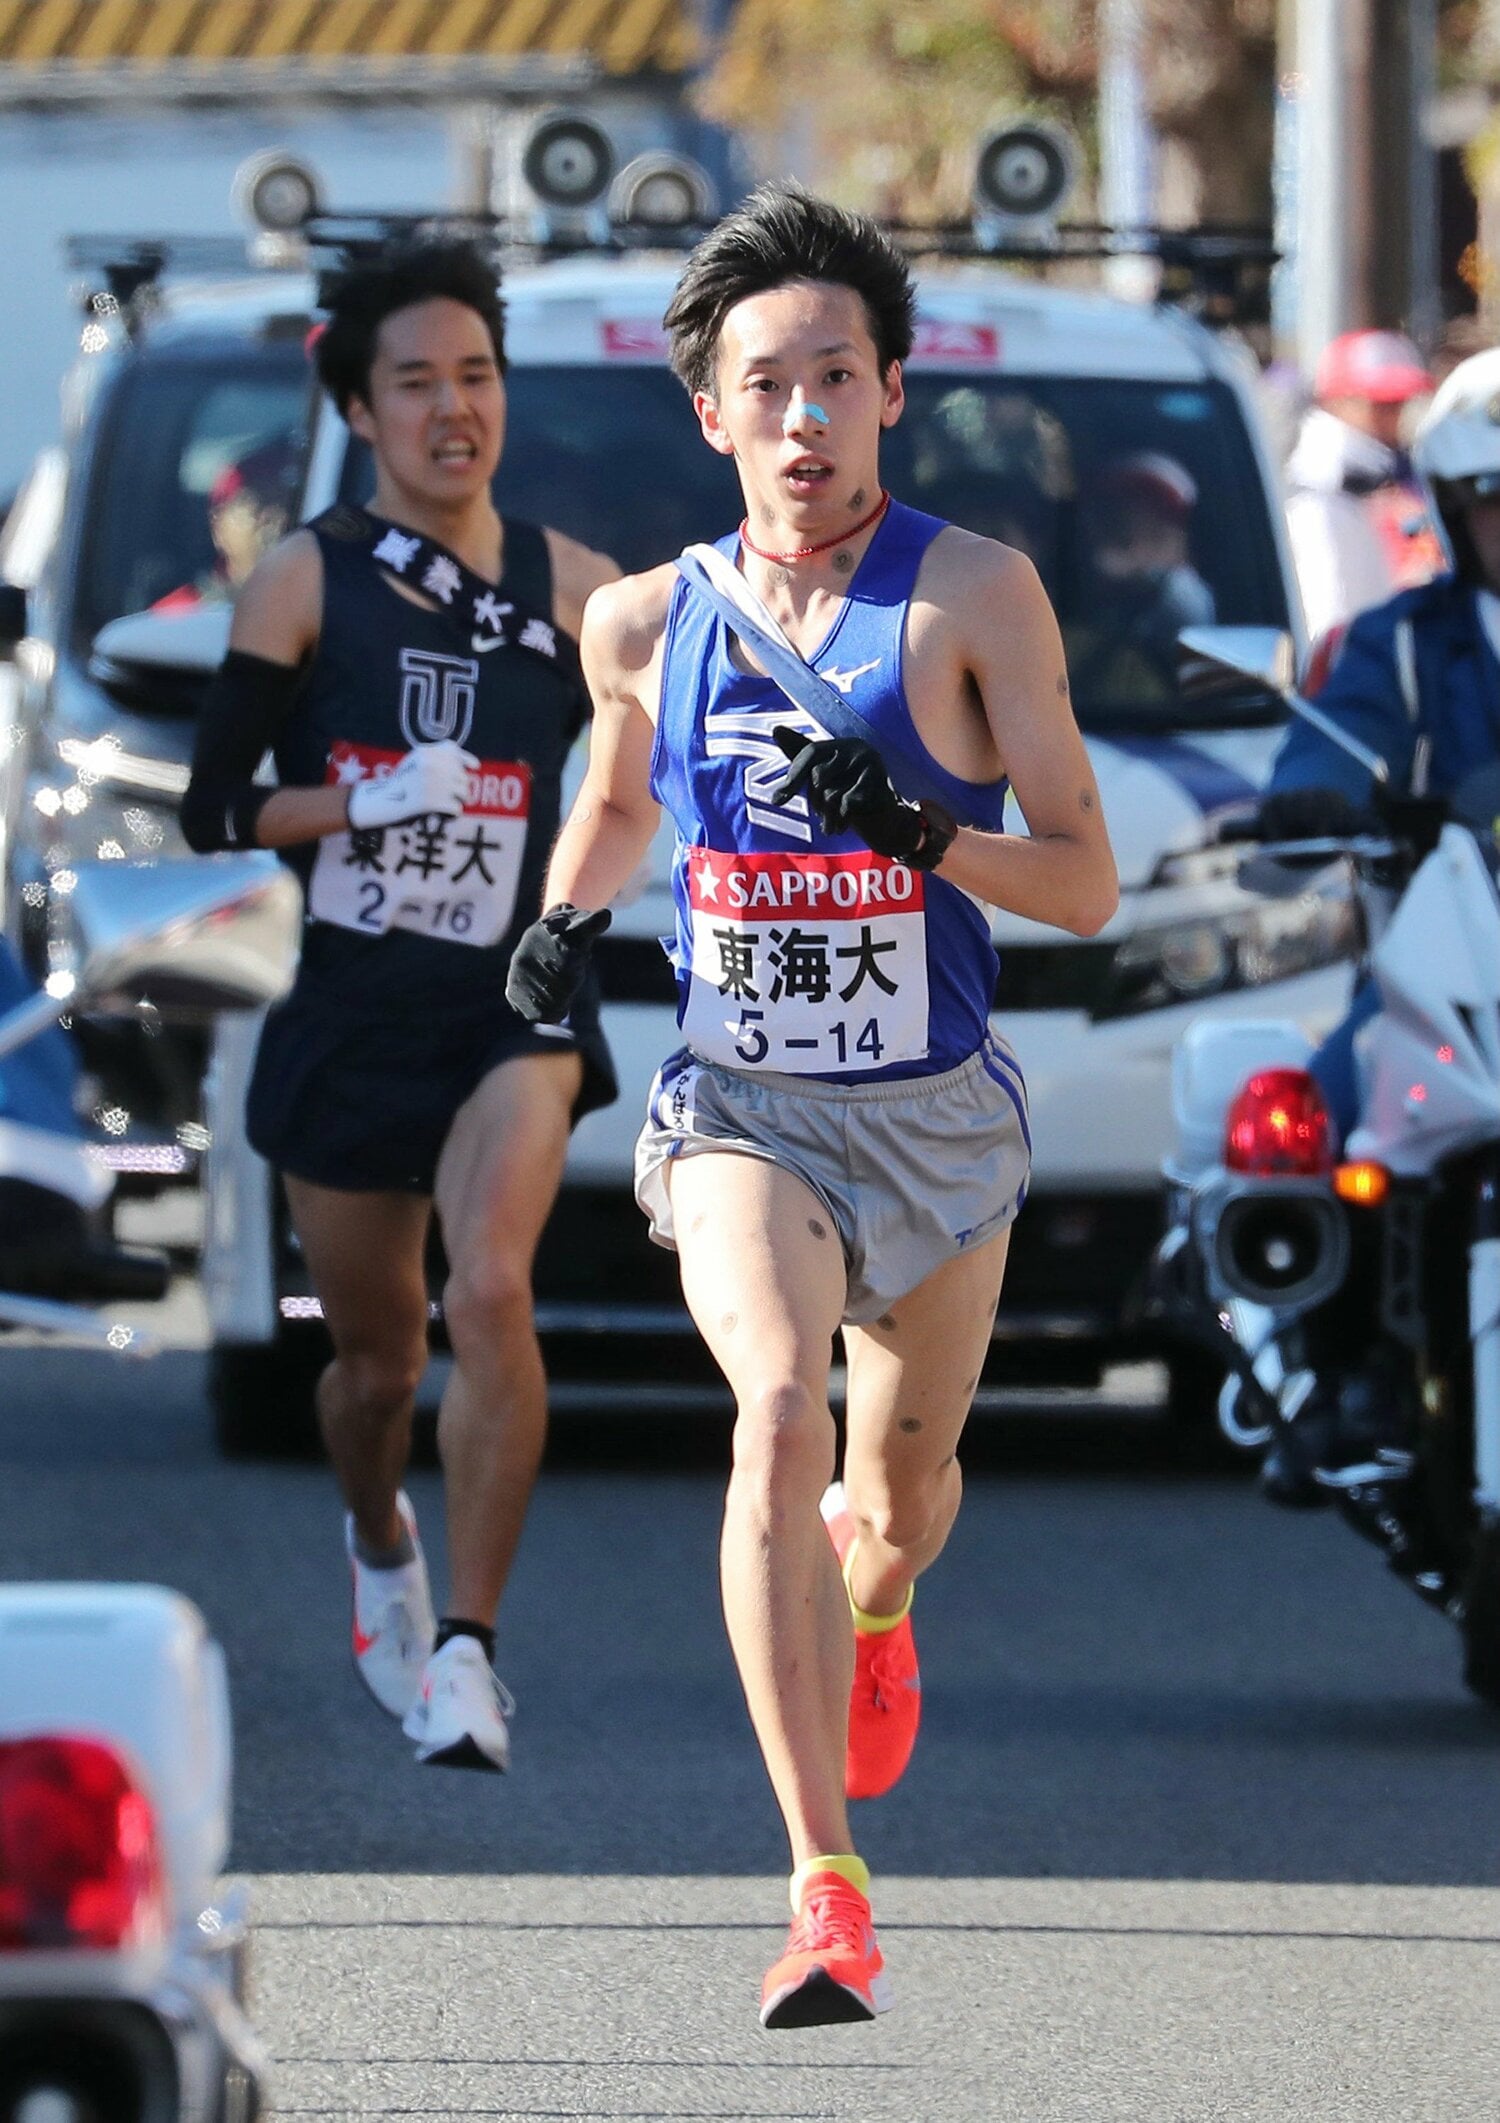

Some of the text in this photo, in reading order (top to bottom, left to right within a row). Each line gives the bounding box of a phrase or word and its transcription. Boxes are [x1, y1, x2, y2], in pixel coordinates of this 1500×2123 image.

[343, 815, 501, 886] 東洋大
[357, 880, 475, 935] 2-16
[726, 864, 913, 908] SAPPORO
[712, 925, 899, 1004] 東海大
[734, 1008, 884, 1064] 5-14
